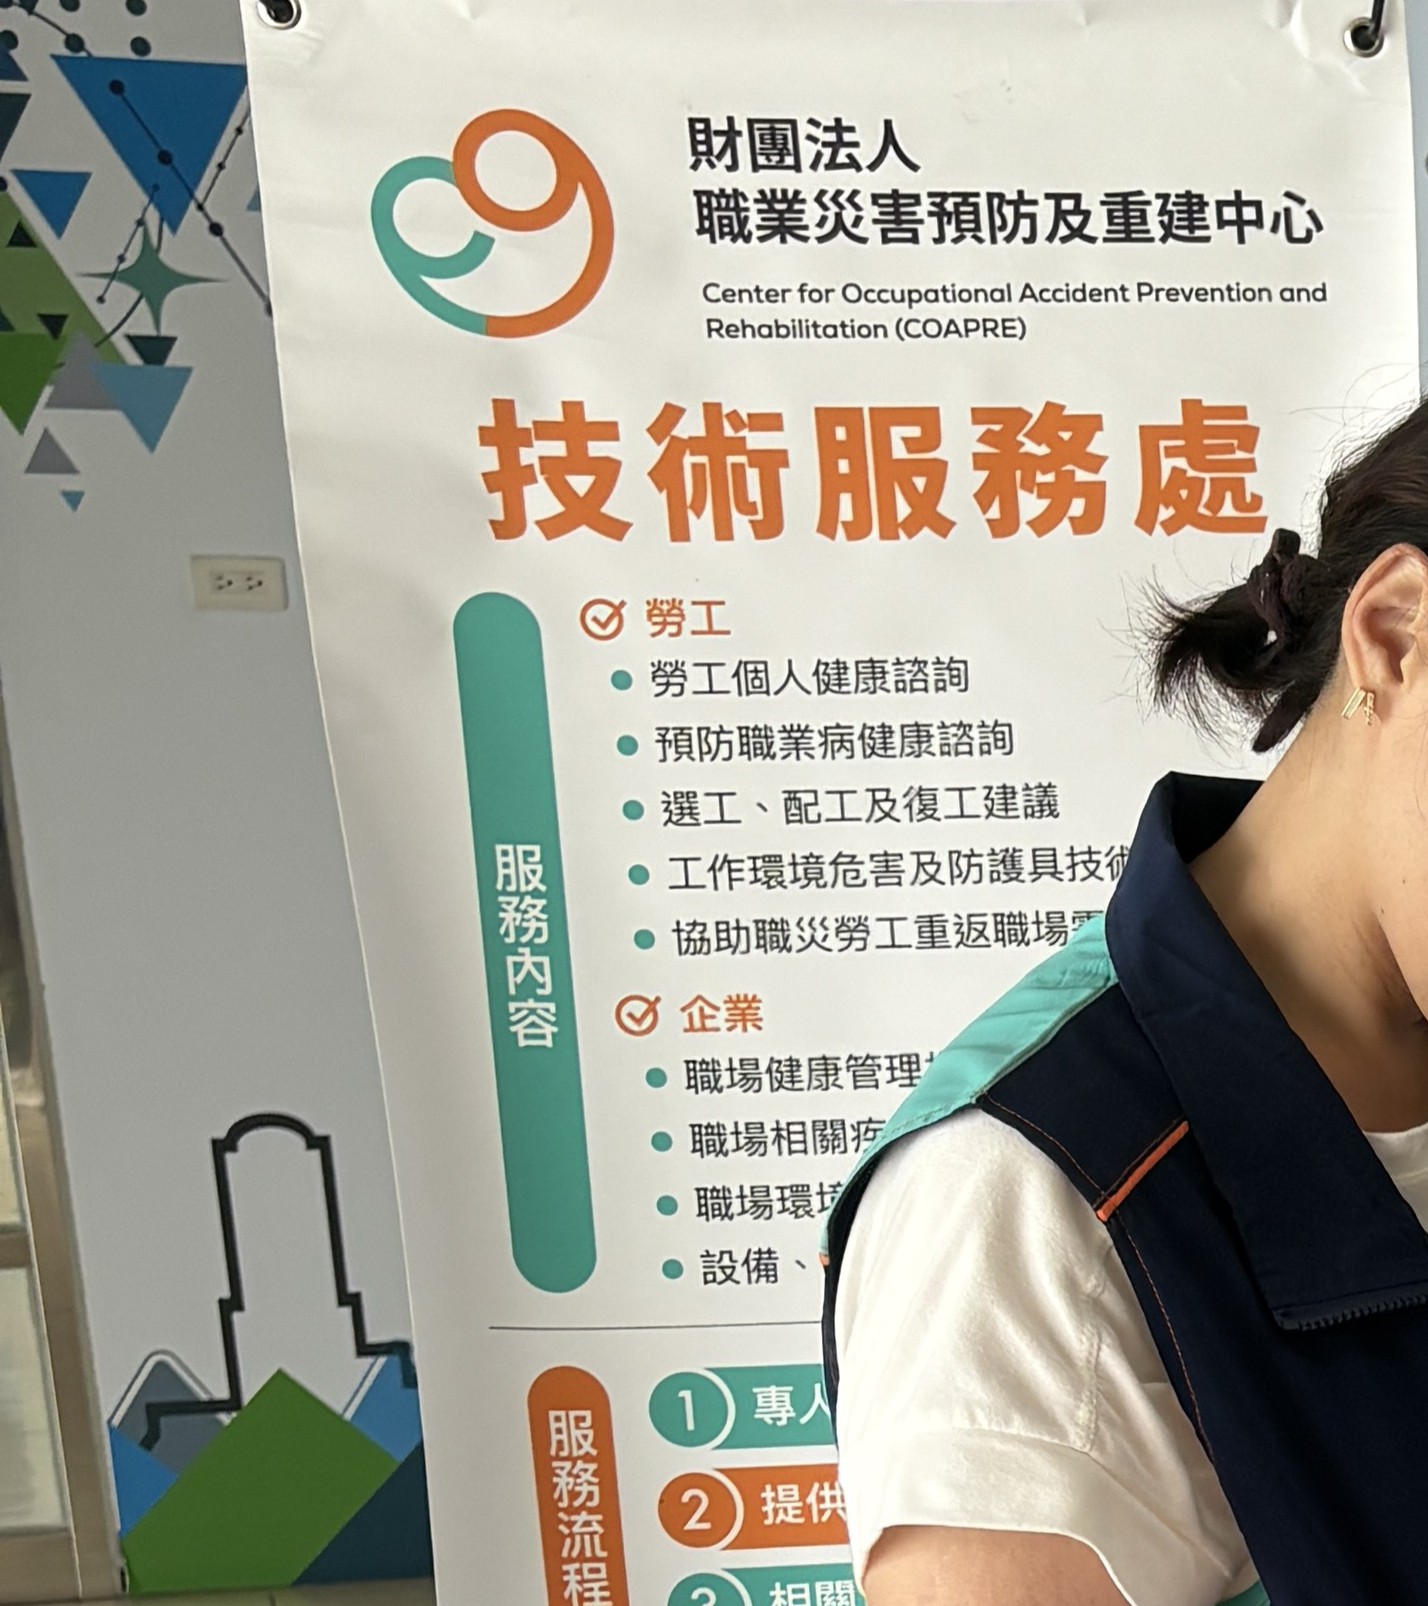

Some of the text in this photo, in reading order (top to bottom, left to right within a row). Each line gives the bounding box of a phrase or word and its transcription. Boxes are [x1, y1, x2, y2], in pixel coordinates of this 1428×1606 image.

[688, 116, 921, 173] 財團法人
[693, 189, 1324, 245] 職業災害預防及重建中心
[703, 281, 1328, 308] Center for Occupational Accident Prevention and
[706, 317, 1026, 341] Rehabilitation (COAPRE)
[478, 398, 1268, 542] 技術服務處
[646, 599, 732, 638] 勞工
[650, 657, 970, 698] 勞工個人健康諮詢
[655, 720, 1015, 763] 預防職業病健康諮詢
[661, 782, 1060, 827] 選工、配工及復工建議
[494, 843, 558, 1048] 服務內容
[679, 993, 763, 1034] 企業
[685, 1051, 936, 1095] 職場健康管理
[700, 1248, 806, 1286] 設備、
[677, 1383, 831, 1432] 1 專人
[680, 1481, 846, 1531] 2 提供
